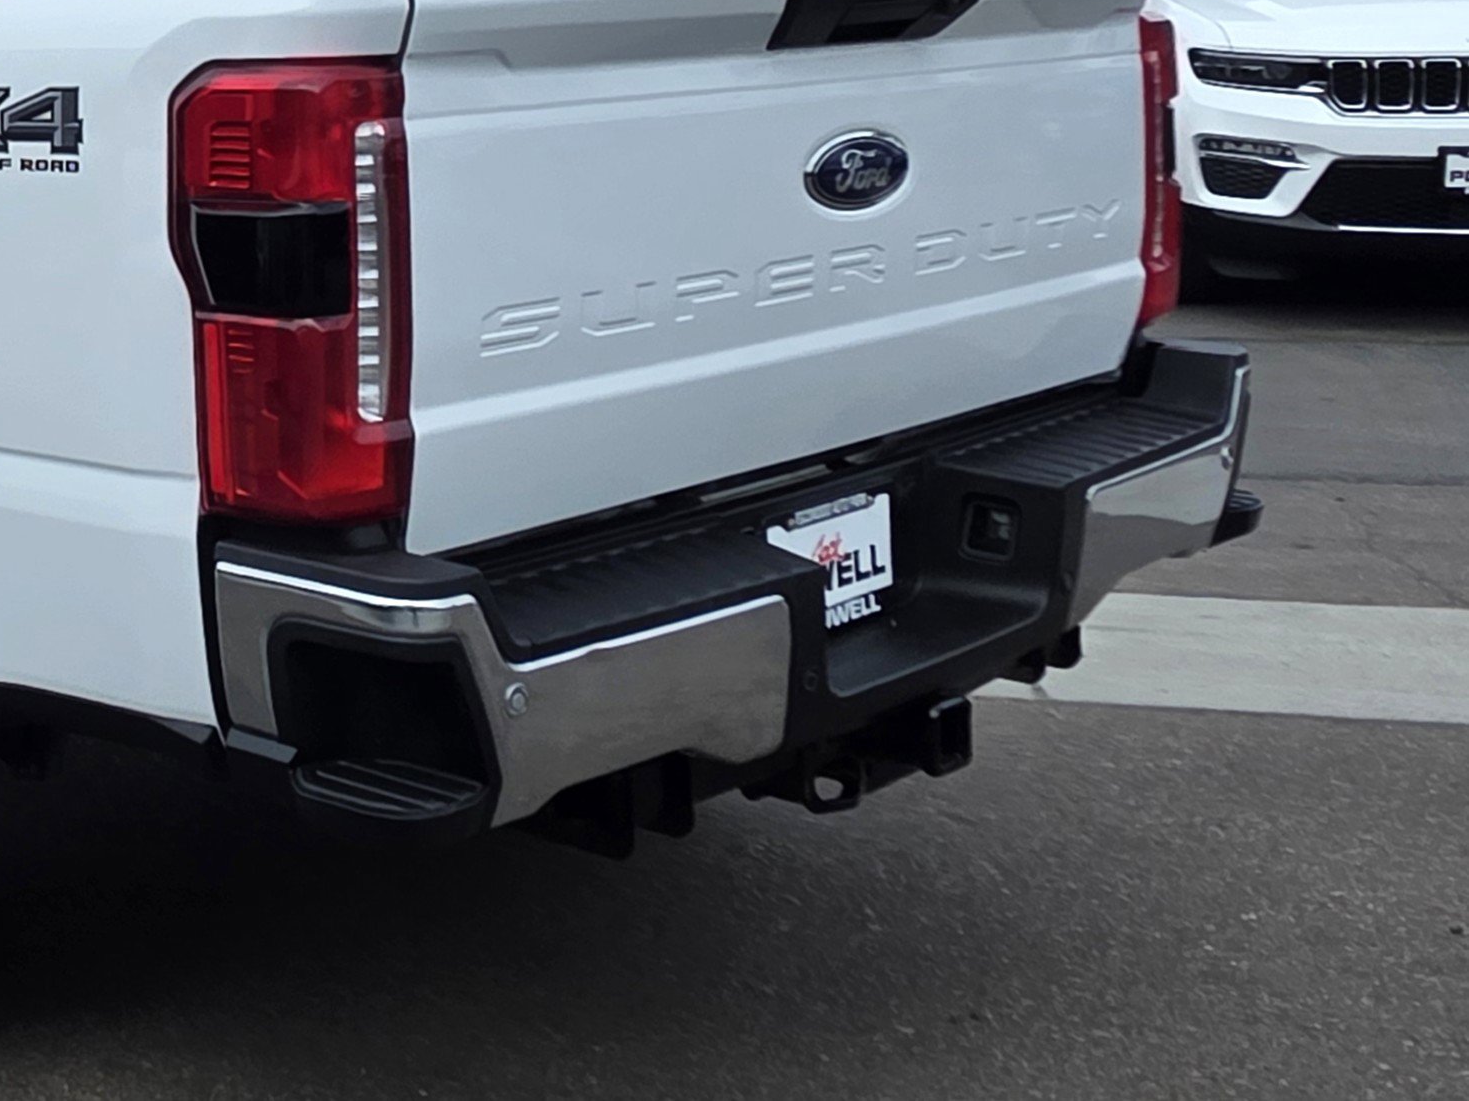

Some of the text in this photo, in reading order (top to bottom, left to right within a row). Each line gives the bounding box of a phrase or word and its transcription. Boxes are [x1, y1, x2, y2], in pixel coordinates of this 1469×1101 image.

[19, 158, 81, 174] ROAD
[835, 148, 892, 193] Ford
[479, 198, 1121, 358] SUPER DUTY
